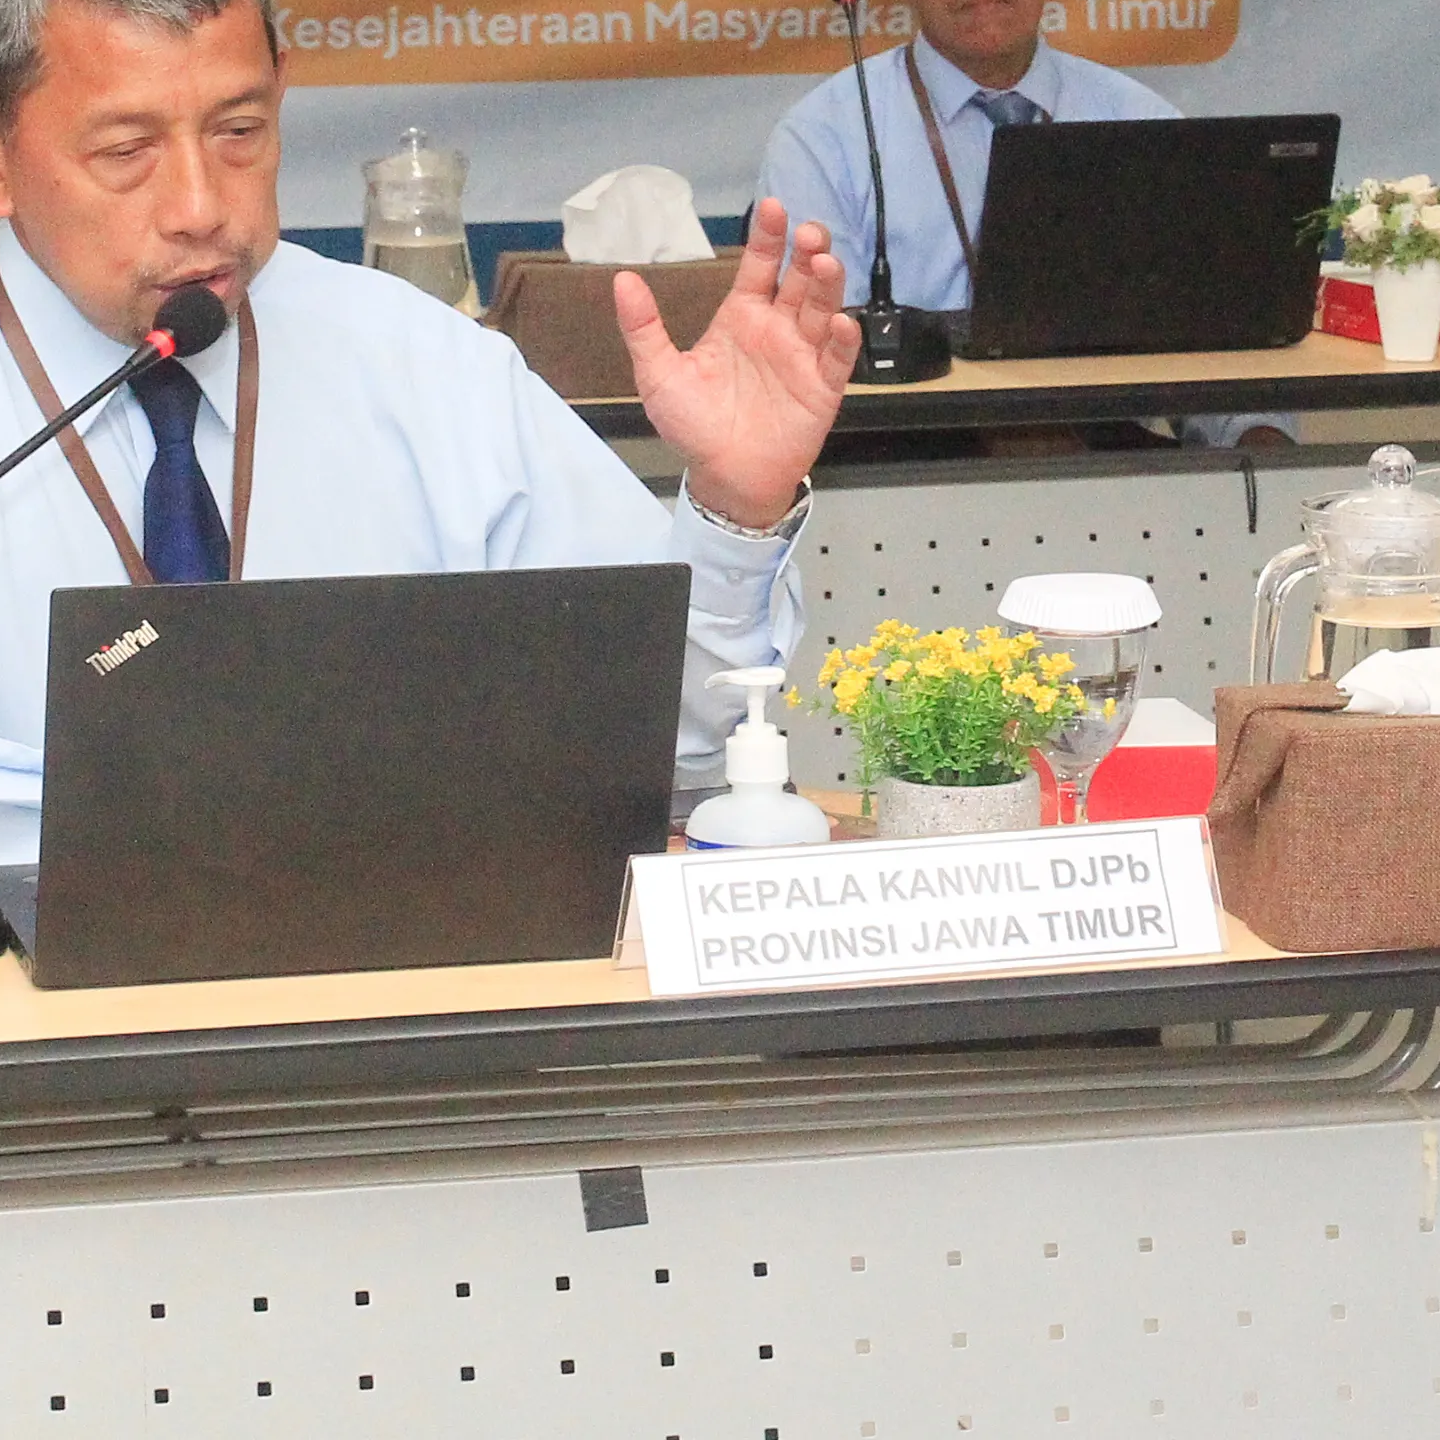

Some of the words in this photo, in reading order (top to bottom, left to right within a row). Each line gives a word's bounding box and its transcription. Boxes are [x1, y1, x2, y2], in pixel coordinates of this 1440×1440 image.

[85, 619, 160, 676] ThinkPad
[698, 873, 868, 915] KEPALA
[878, 862, 1041, 902] KANWIL
[1050, 853, 1151, 889] DJPb
[701, 923, 898, 970] PROVINSI
[911, 915, 1030, 954] JAWA
[1038, 902, 1166, 942] TIMUR
